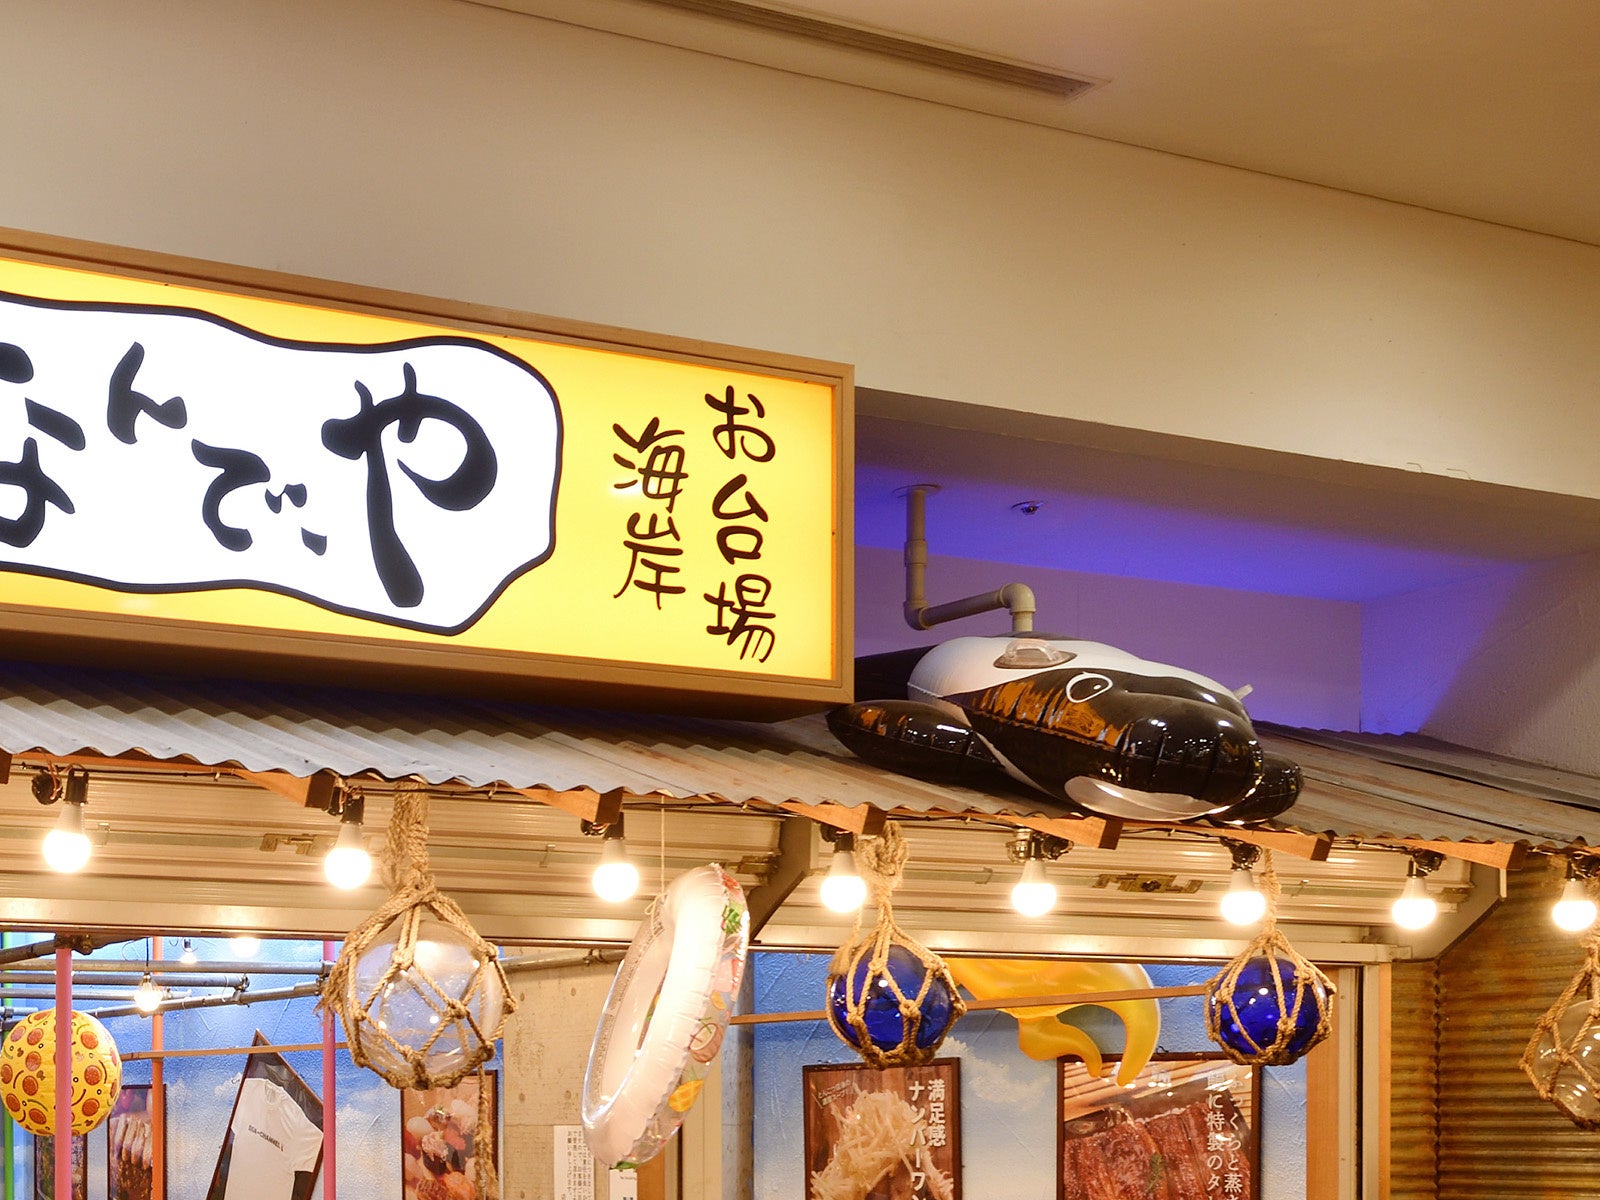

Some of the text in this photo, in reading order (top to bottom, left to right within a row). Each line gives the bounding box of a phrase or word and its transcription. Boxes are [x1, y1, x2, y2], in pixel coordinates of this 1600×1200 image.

[612, 416, 689, 611] 海岸
[703, 384, 776, 663] お台場
[927, 1078, 946, 1147] 満足感
